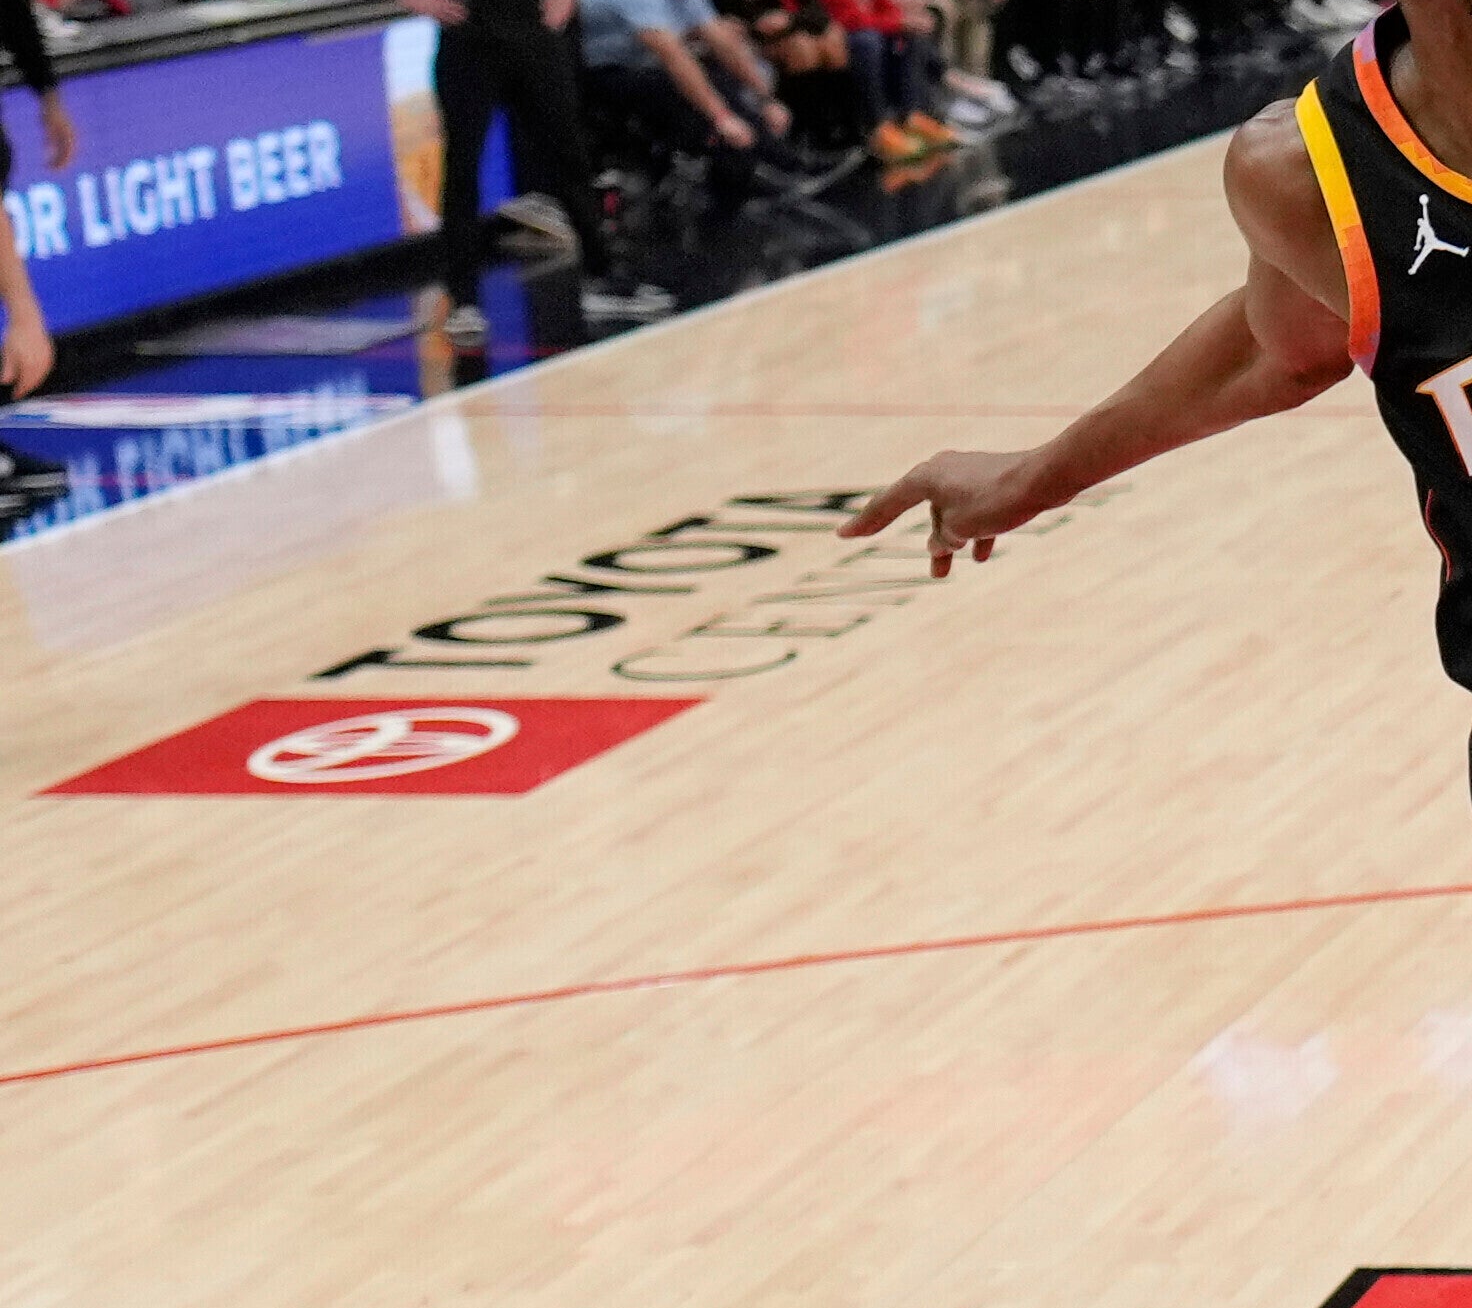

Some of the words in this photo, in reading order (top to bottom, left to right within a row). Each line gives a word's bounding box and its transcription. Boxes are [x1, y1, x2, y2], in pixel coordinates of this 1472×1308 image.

[76, 145, 218, 247] LIGHT
[226, 119, 344, 212] BEER
[309, 485, 888, 682] TOYOTA
